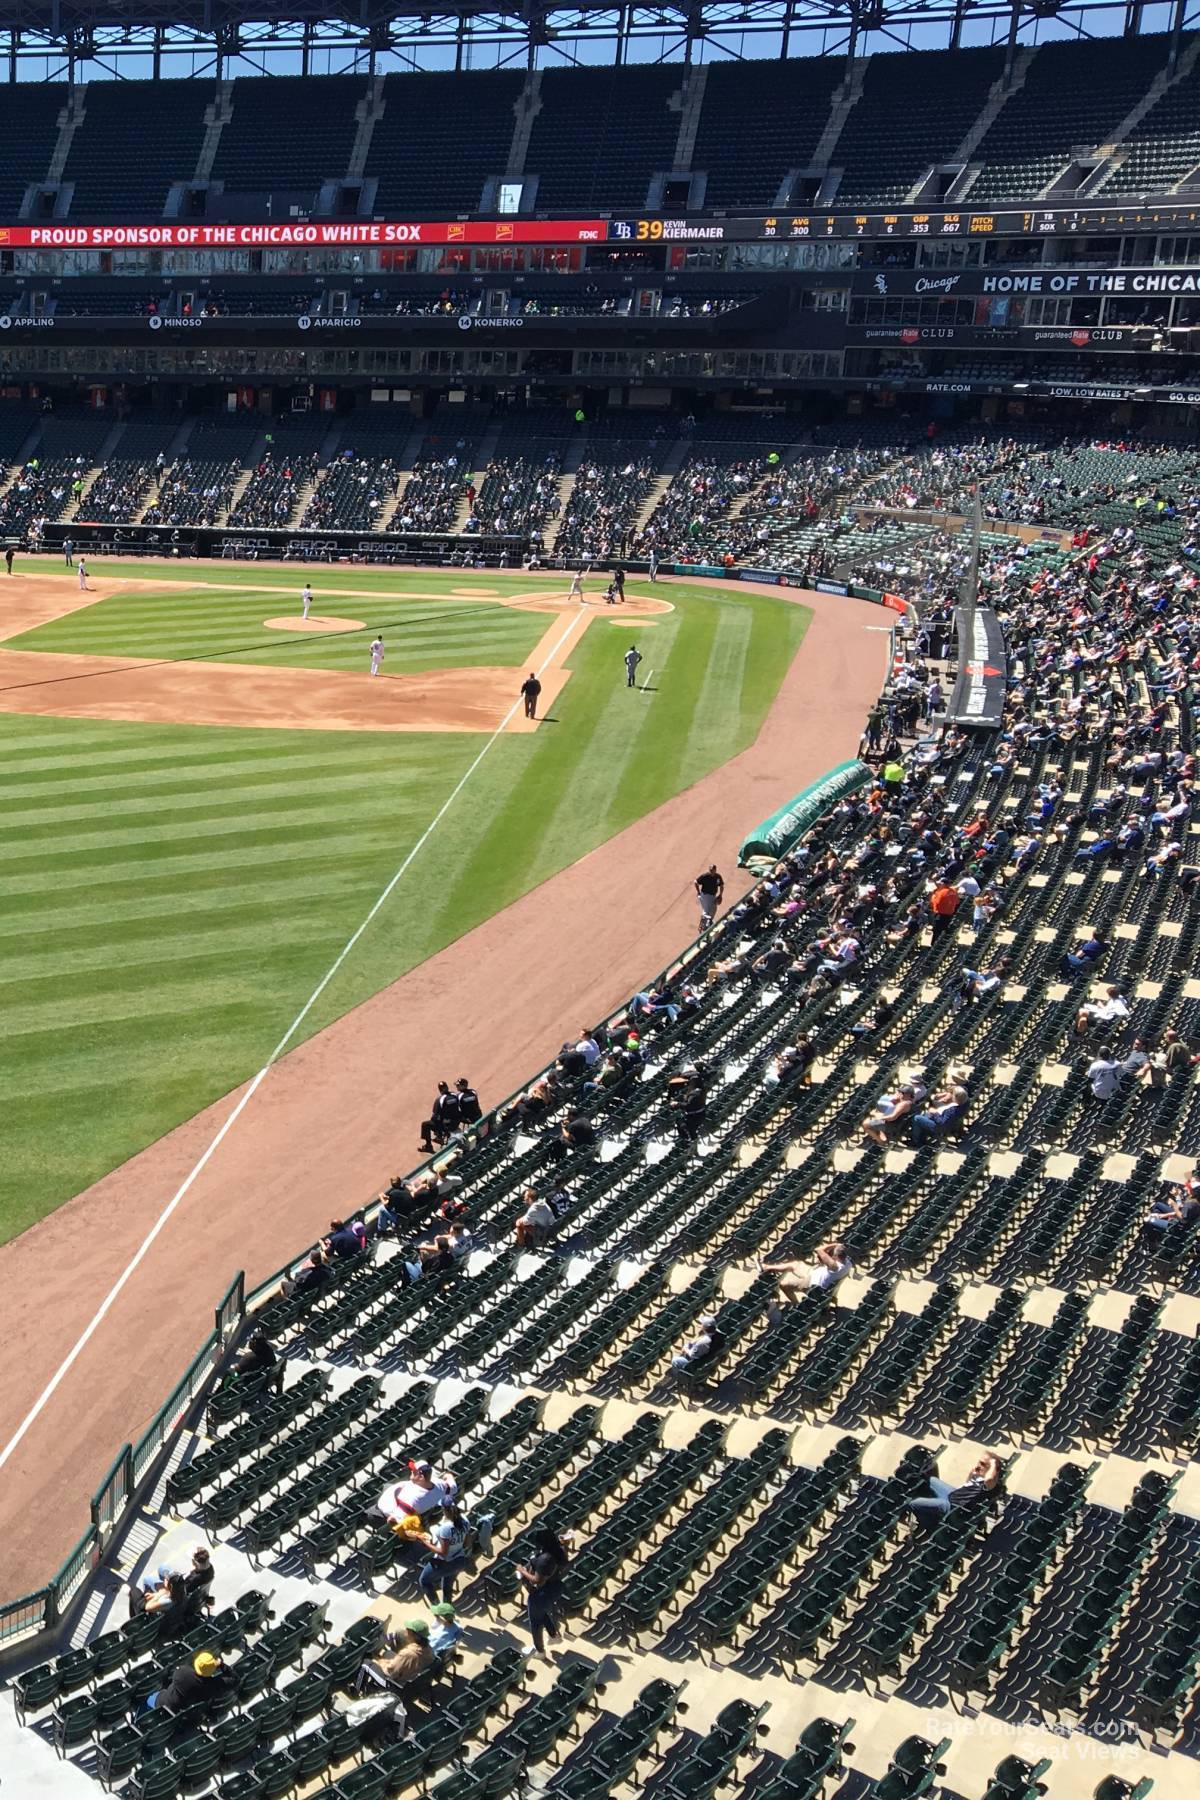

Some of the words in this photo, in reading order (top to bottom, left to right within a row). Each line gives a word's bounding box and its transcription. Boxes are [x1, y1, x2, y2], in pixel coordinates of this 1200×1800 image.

[663, 220, 686, 228] KEVIN
[765, 218, 777, 226] AB
[791, 218, 809, 226] AVG
[827, 217, 834, 225] H
[855, 216, 867, 225] HR
[884, 216, 898, 224] RBI
[912, 215, 929, 224] OBP
[943, 214, 959, 223] SLG
[972, 216, 994, 225] PITCH
[636, 220, 663, 240] 39
[764, 227, 776, 236] 30
[790, 226, 809, 235] .300
[827, 226, 833, 235] 9
[857, 225, 864, 234] 2
[887, 224, 893, 234] 6
[910, 224, 929, 233] .353
[940, 223, 960, 233] .667
[970, 224, 993, 232] SPEED
[1039, 223, 1056, 231] SOX
[30, 229, 88, 243] PROUD
[92, 228, 172, 243] SPONSOR
[177, 228, 199, 242] OF
[203, 227, 236, 242] THE
[240, 226, 317, 242] CHICAGO
[322, 226, 379, 241] WHITE
[384, 225, 421, 240] SOX
[578, 230, 598, 240] FDIC
[662, 227, 724, 239] KIERMAIER
[915, 274, 960, 293] Chicago
[983, 276, 1043, 292] HOME
[1050, 276, 1079, 291] OF
[1087, 275, 1127, 291] THE
[1132, 275, 1200, 291] CHICA
[14, 317, 55, 327] APPLING
[164, 317, 202, 327] MINOSO
[314, 317, 361, 327] APARICIO
[474, 317, 523, 328] KONERKO
[866, 330, 902, 338] guaranteed
[922, 329, 954, 338] CLUB
[1035, 331, 1072, 341] guaranteed
[1072, 331, 1089, 339] Rate
[1092, 331, 1123, 340] CLUB
[926, 383, 971, 392] RATE.COM
[1050, 388, 1073, 396] LOW,
[1075, 389, 1095, 397] LOW
[1096, 390, 1122, 398] RATES
